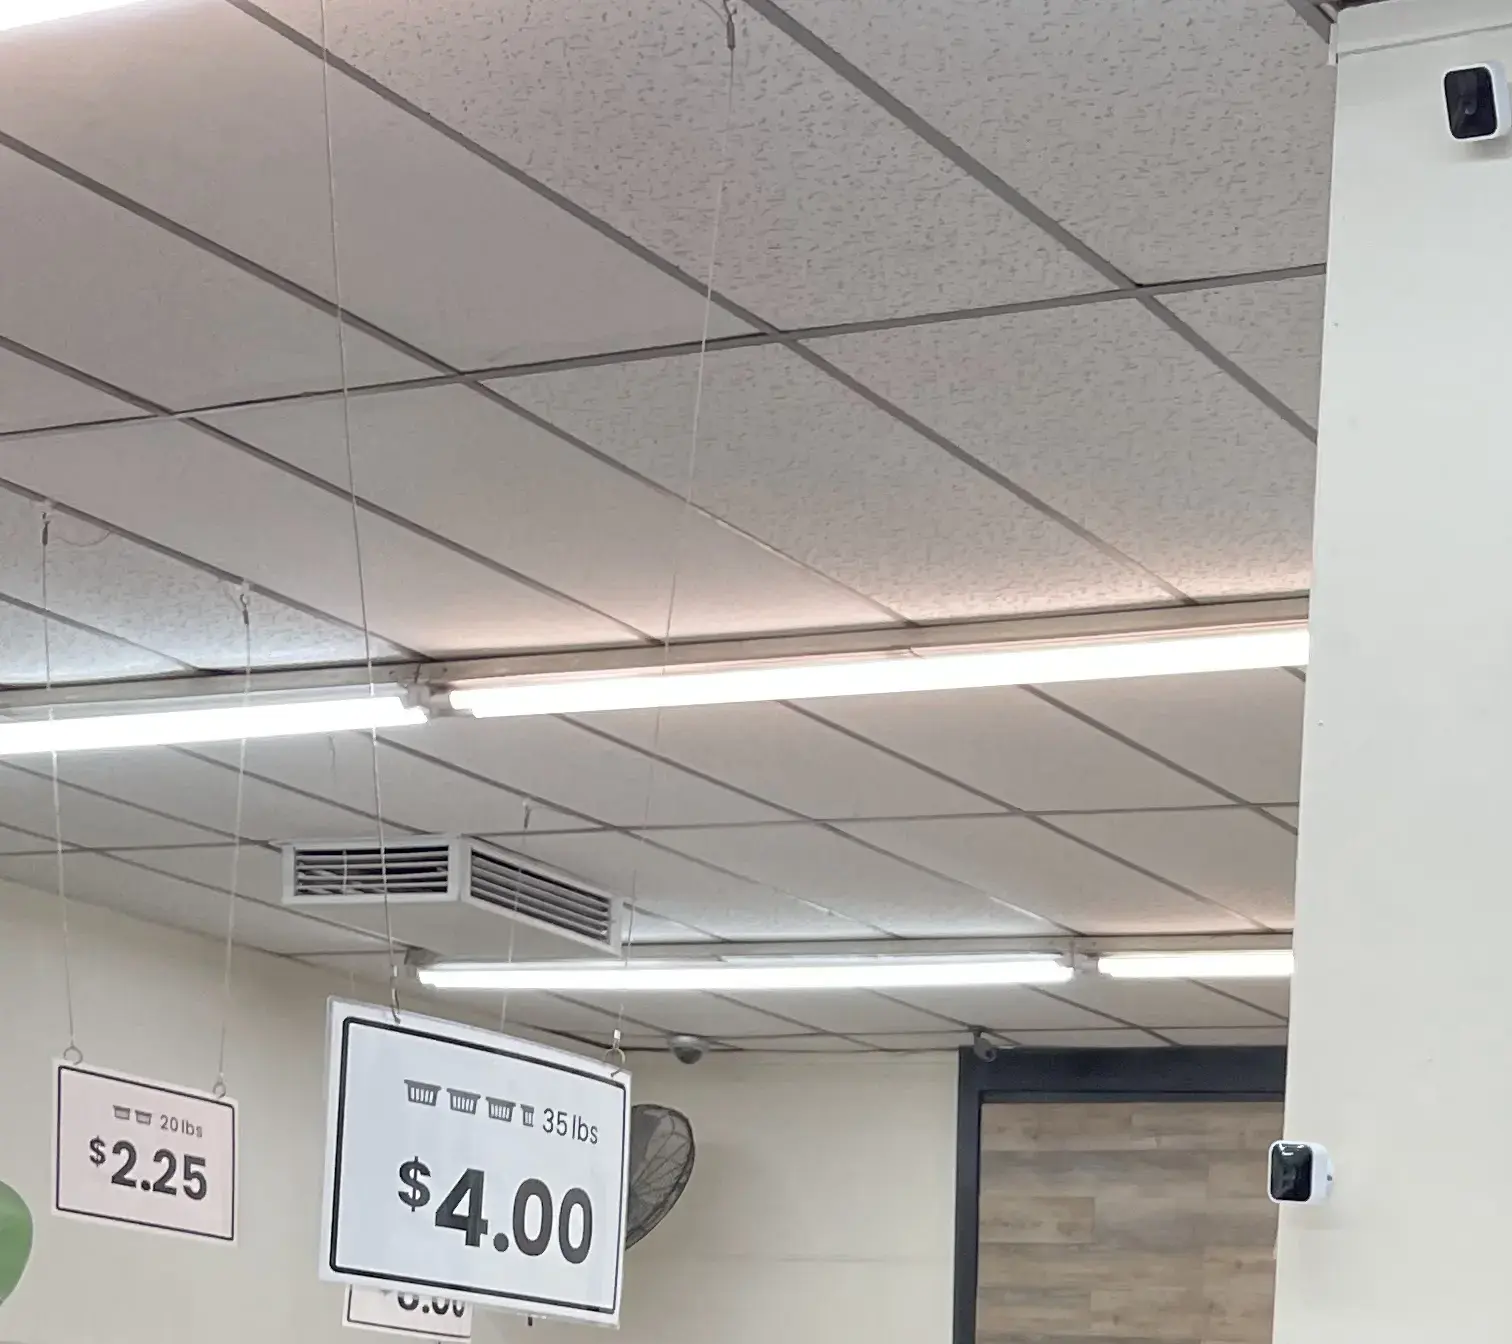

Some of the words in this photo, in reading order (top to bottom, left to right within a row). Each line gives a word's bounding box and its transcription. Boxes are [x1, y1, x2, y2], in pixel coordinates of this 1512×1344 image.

[160, 1114, 179, 1132] 20
[181, 1121, 203, 1138] lbs
[542, 1107, 567, 1136] 35
[571, 1114, 598, 1144] lbs
[89, 1135, 207, 1201] $2.25
[398, 1155, 593, 1264] $4.00
